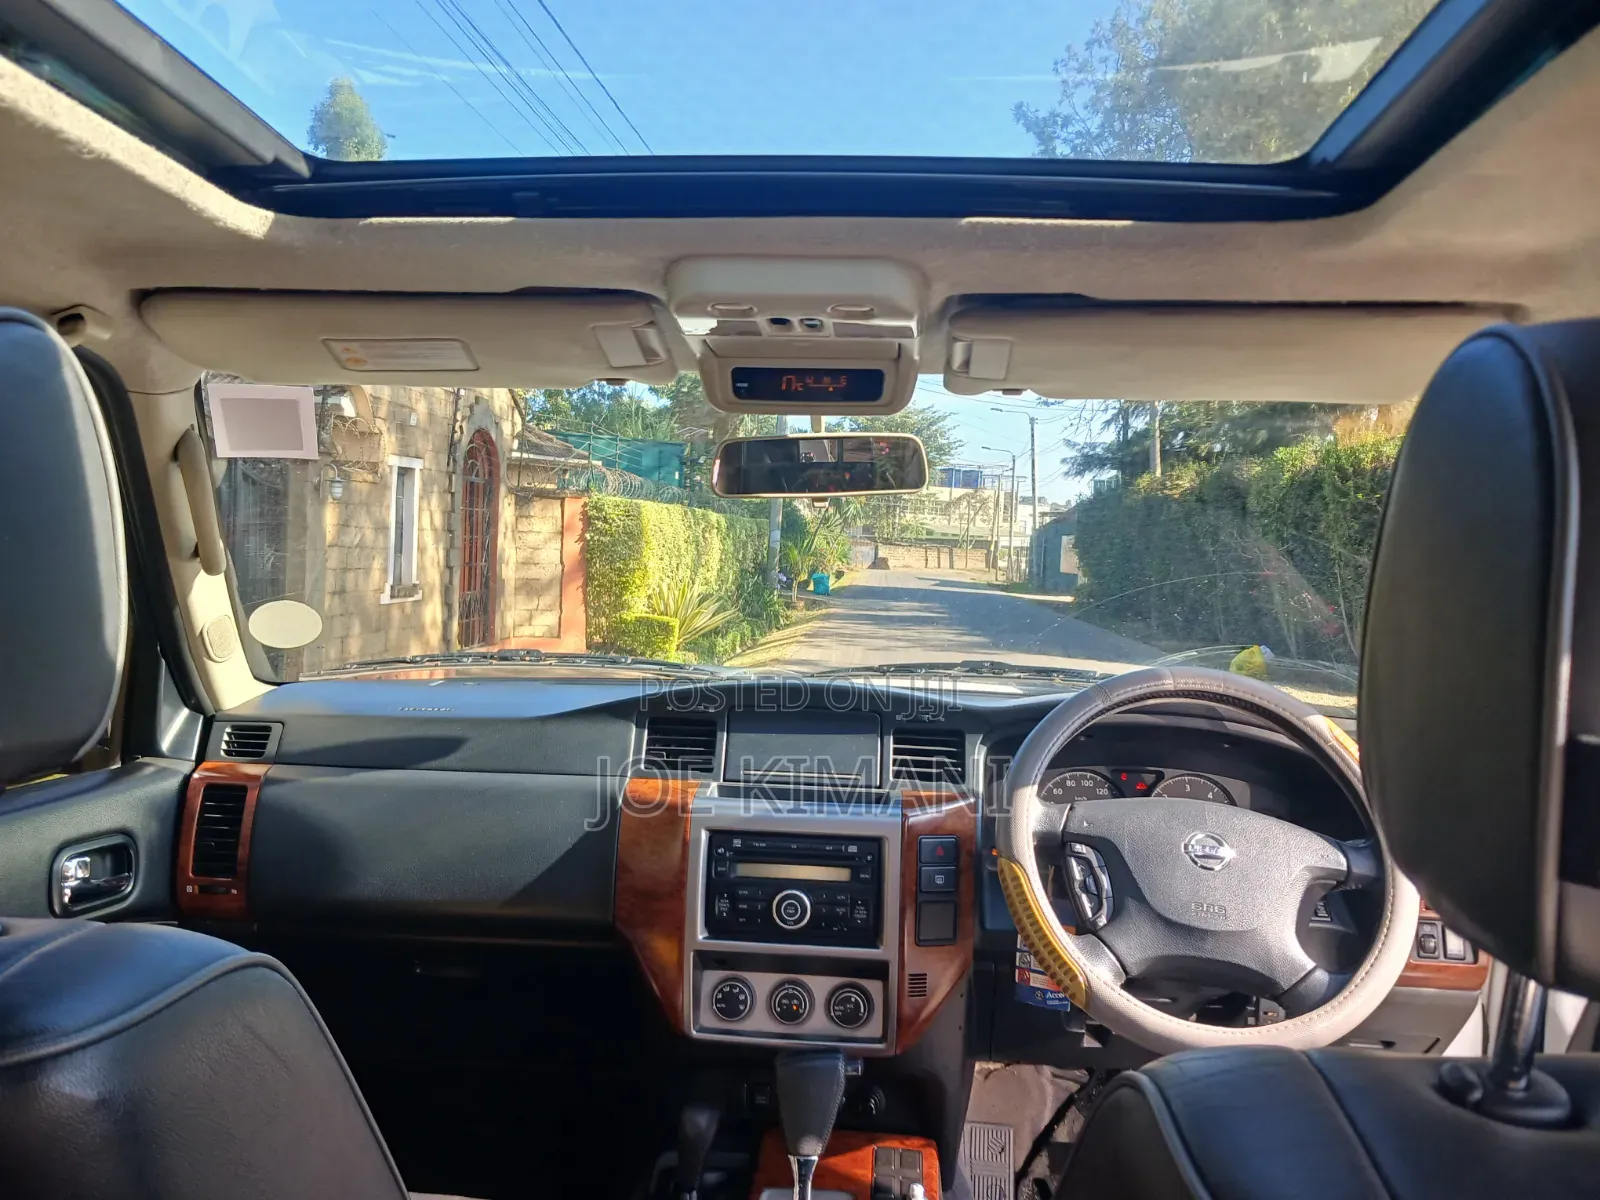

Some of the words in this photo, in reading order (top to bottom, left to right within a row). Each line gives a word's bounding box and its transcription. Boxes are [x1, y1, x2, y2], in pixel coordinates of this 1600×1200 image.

[1066, 779, 1077, 787] 80
[1080, 779, 1094, 787] 100
[1053, 787, 1063, 795] 60
[1096, 787, 1109, 796] 120
[1185, 784, 1191, 792] 3
[1207, 791, 1214, 799] 4
